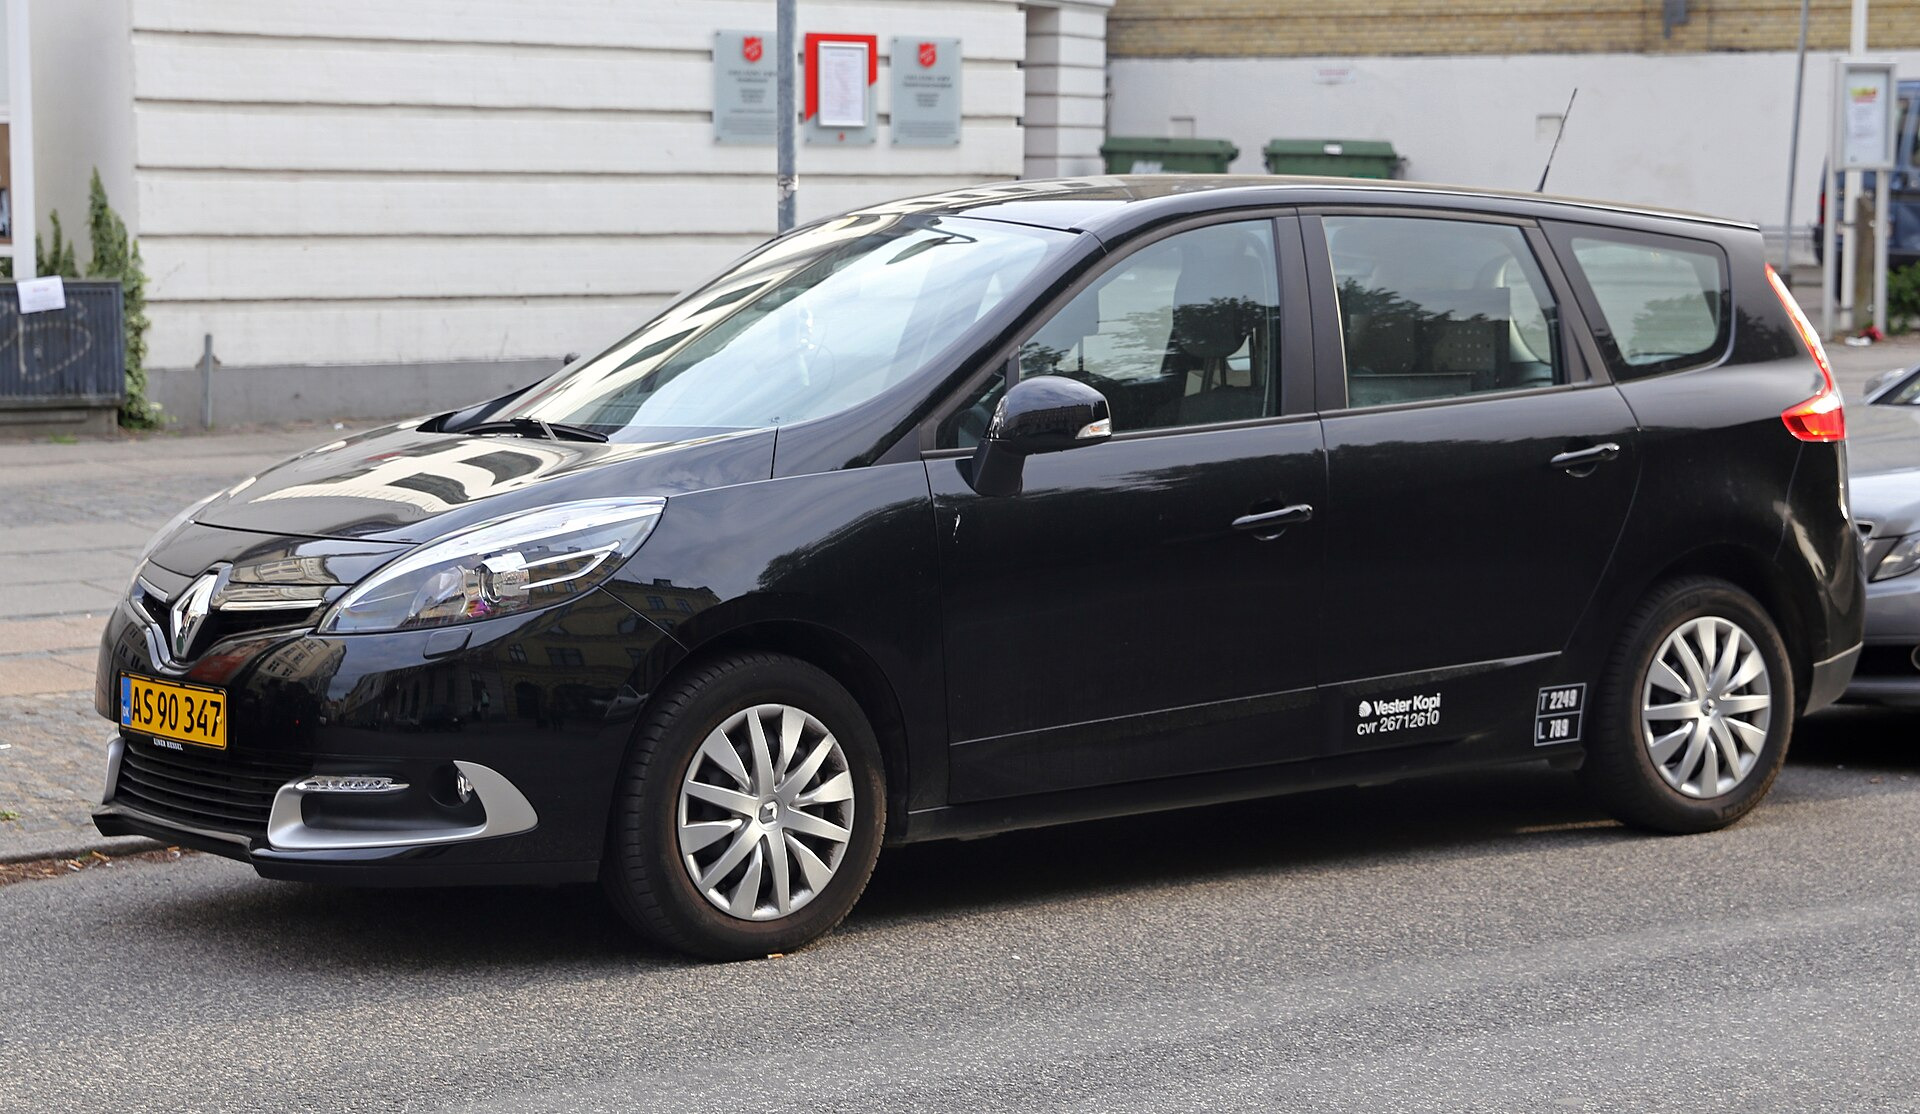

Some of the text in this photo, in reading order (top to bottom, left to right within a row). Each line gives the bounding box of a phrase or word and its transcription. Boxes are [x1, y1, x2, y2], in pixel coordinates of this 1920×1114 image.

[132, 686, 222, 737] AS 90 347
[1373, 692, 1441, 716] Vester Kopi
[1540, 689, 1577, 711] T 2249
[1356, 710, 1440, 736] cvr 26712610
[1537, 718, 1569, 740] L 789
